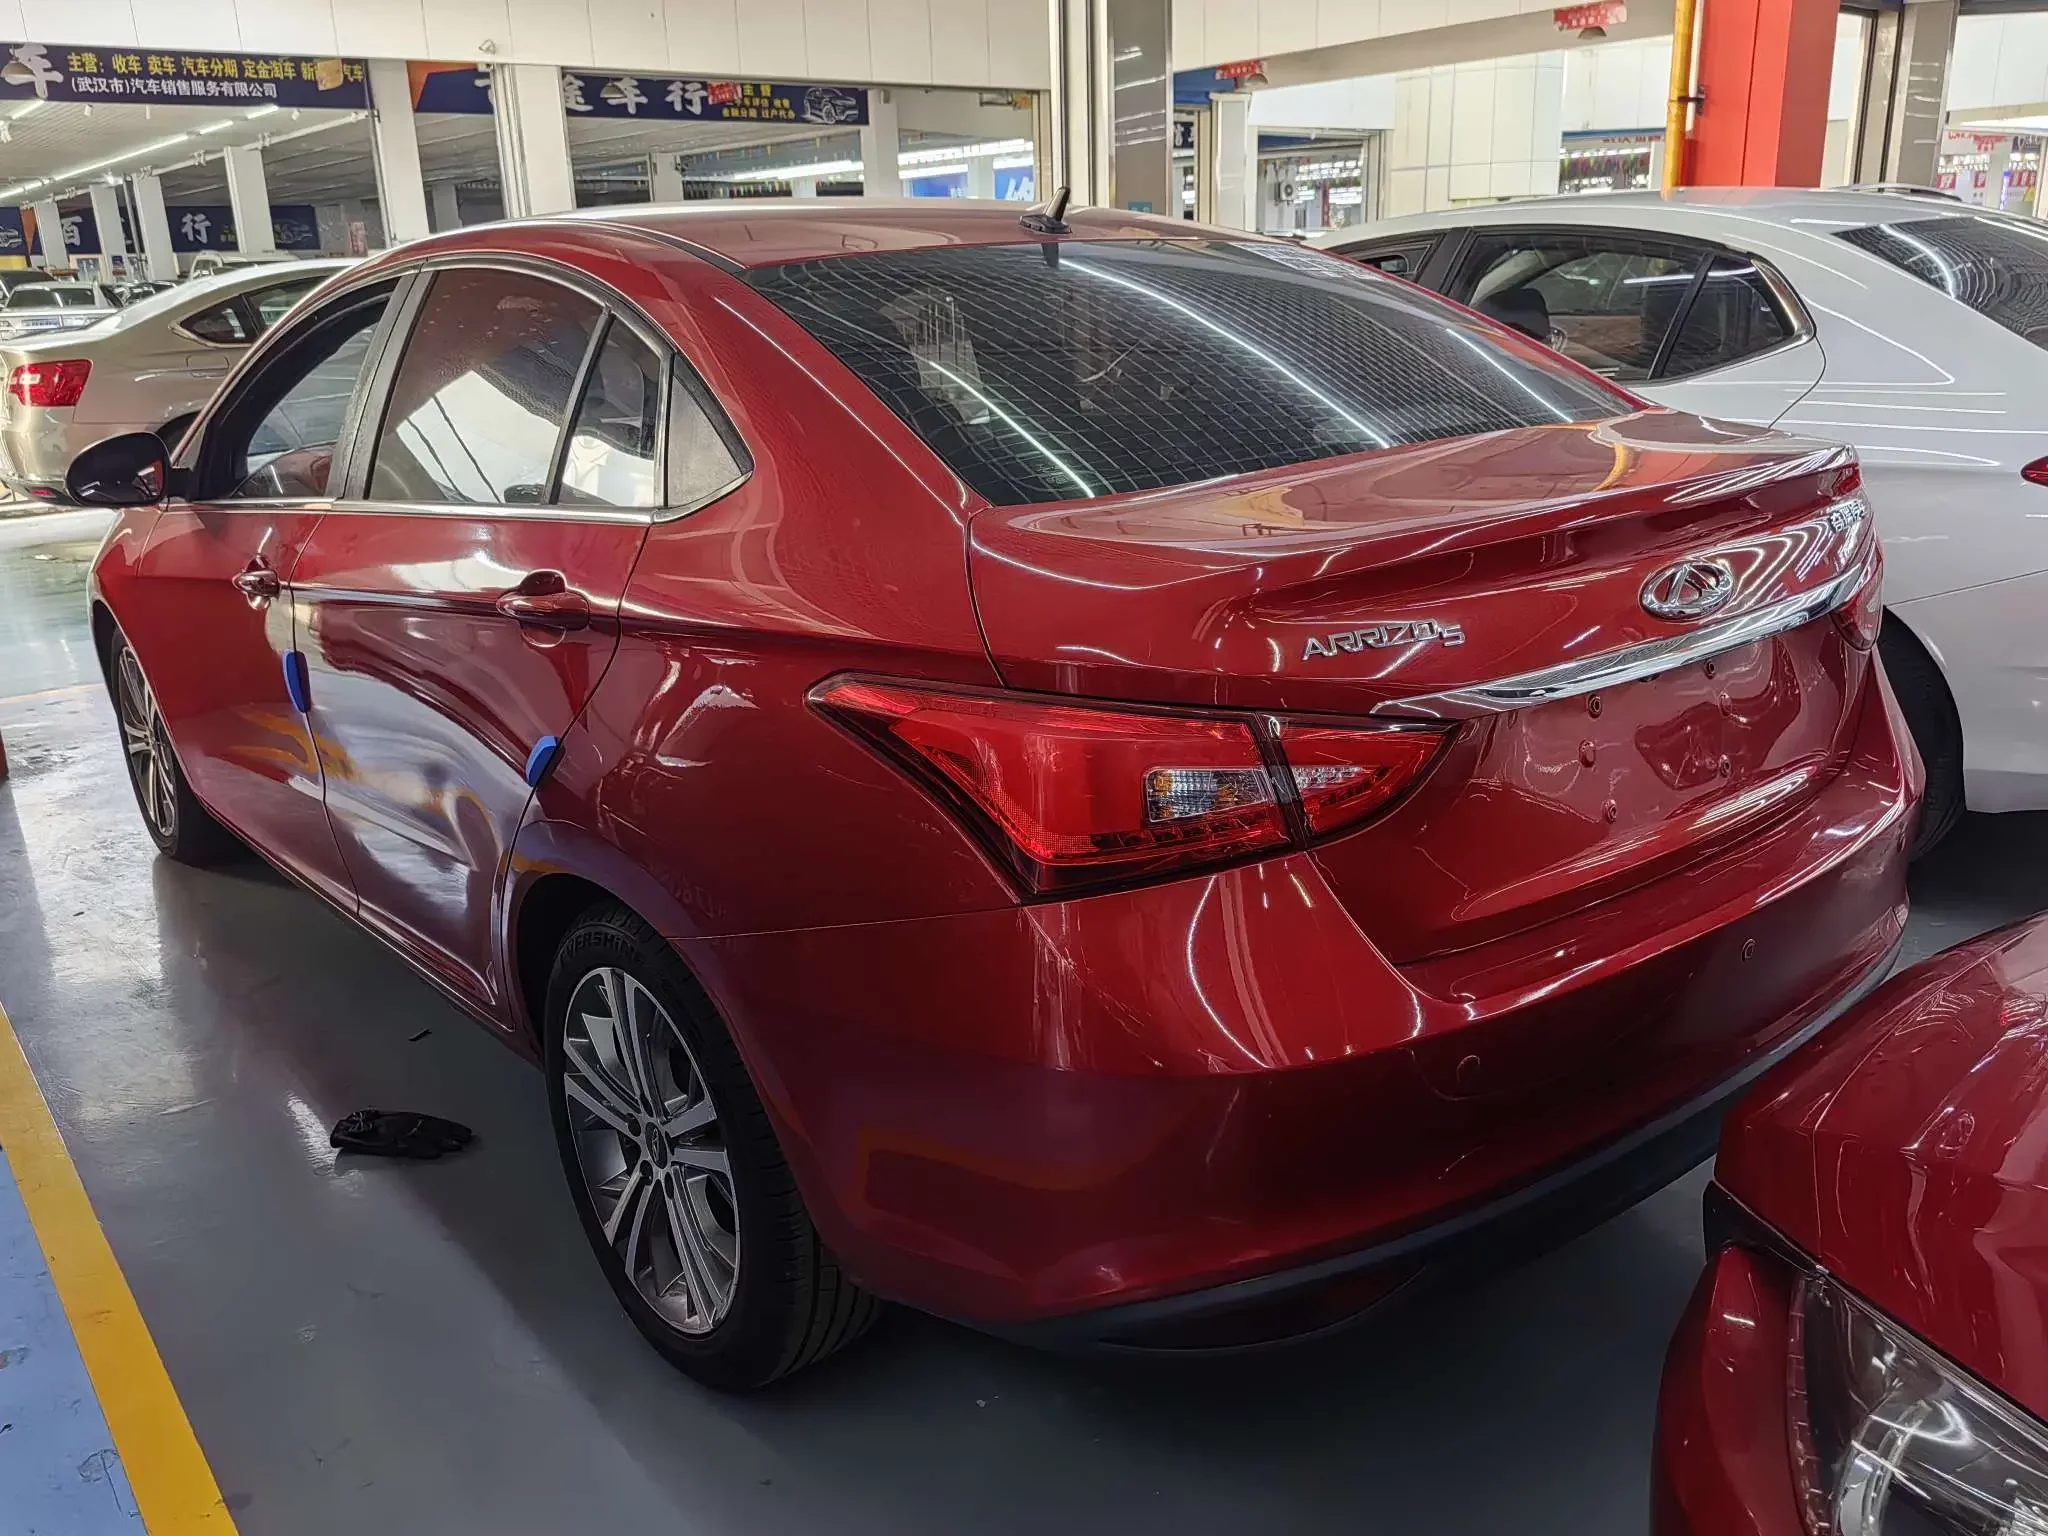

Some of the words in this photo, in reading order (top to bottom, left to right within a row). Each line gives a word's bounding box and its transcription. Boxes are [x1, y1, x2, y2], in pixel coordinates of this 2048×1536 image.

[112, 53, 142, 75] 收车
[147, 54, 177, 76] 卖车
[181, 56, 239, 79] 汽车分期
[181, 212, 212, 243] 行
